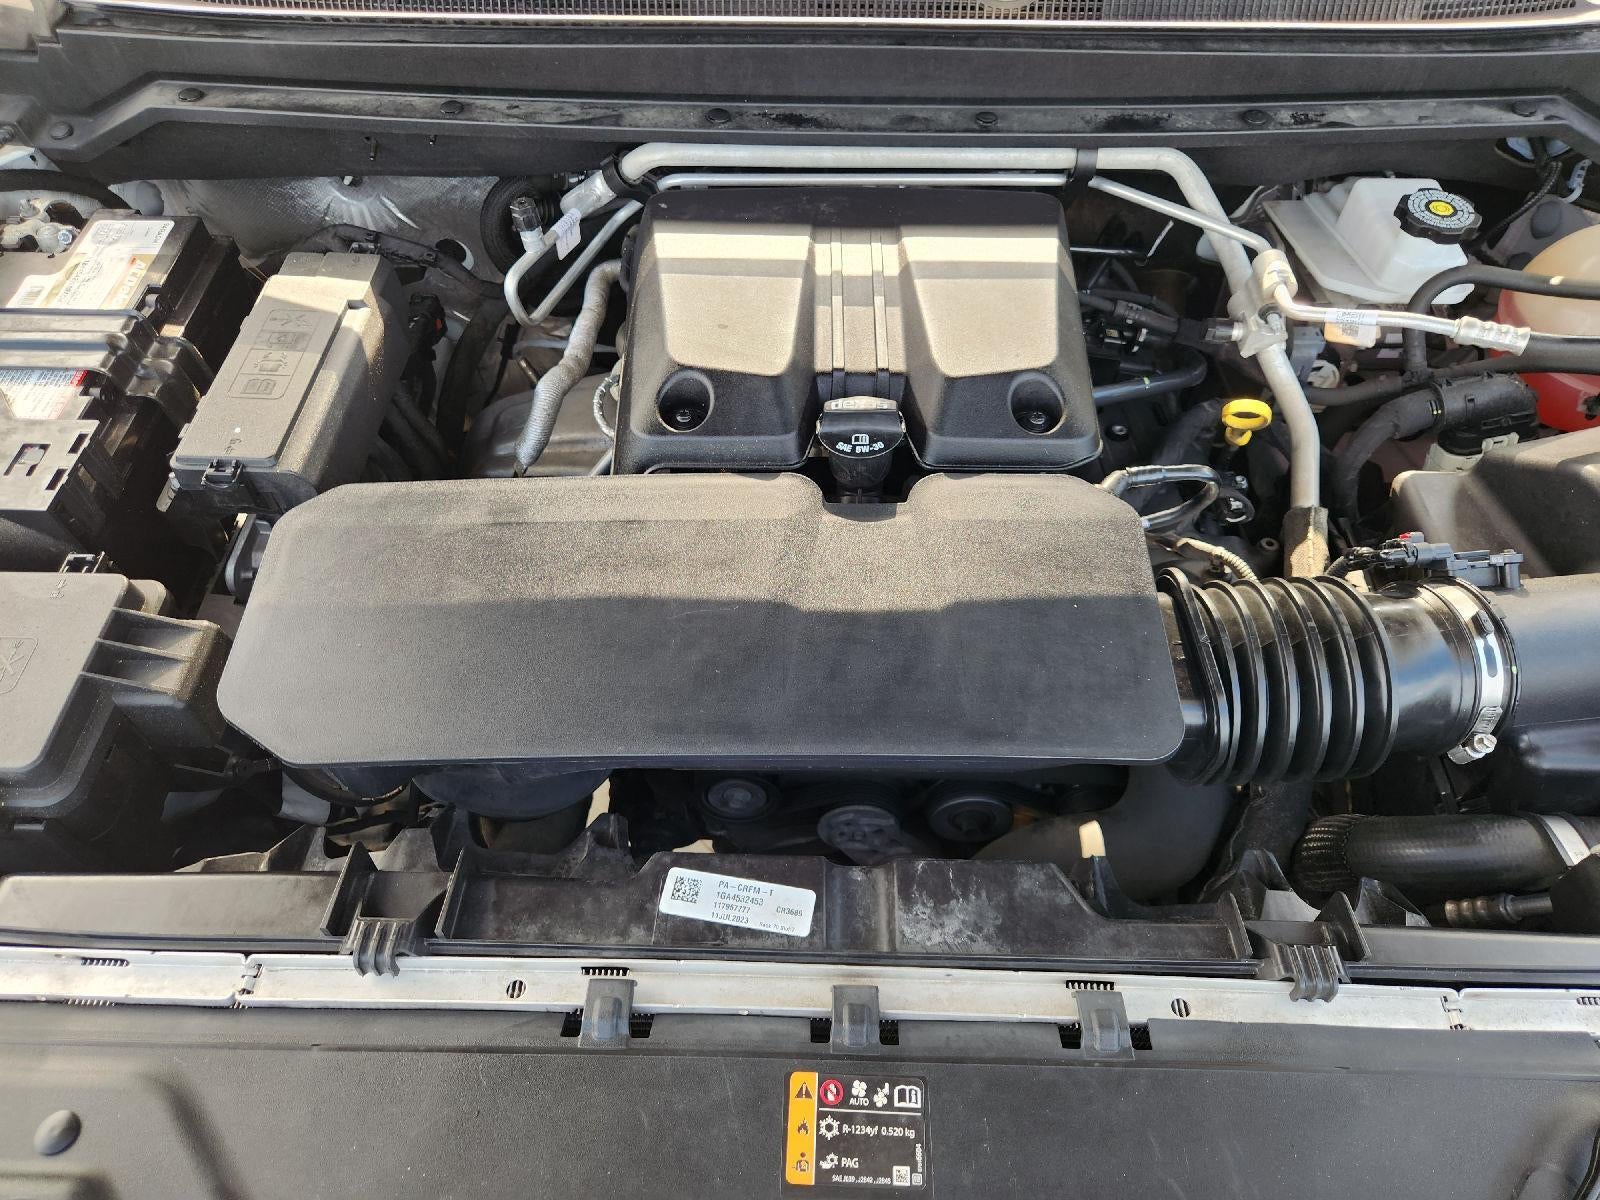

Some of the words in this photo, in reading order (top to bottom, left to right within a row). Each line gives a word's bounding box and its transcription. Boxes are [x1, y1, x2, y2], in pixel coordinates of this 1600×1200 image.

[836, 441, 853, 453] SAE
[855, 441, 885, 454] 5W-30
[849, 1097, 869, 1107] AUTO
[842, 1125, 879, 1136] R-1234yf
[881, 1125, 903, 1137] 0.520
[904, 1126, 915, 1139] kg
[841, 1157, 859, 1169] PAG
